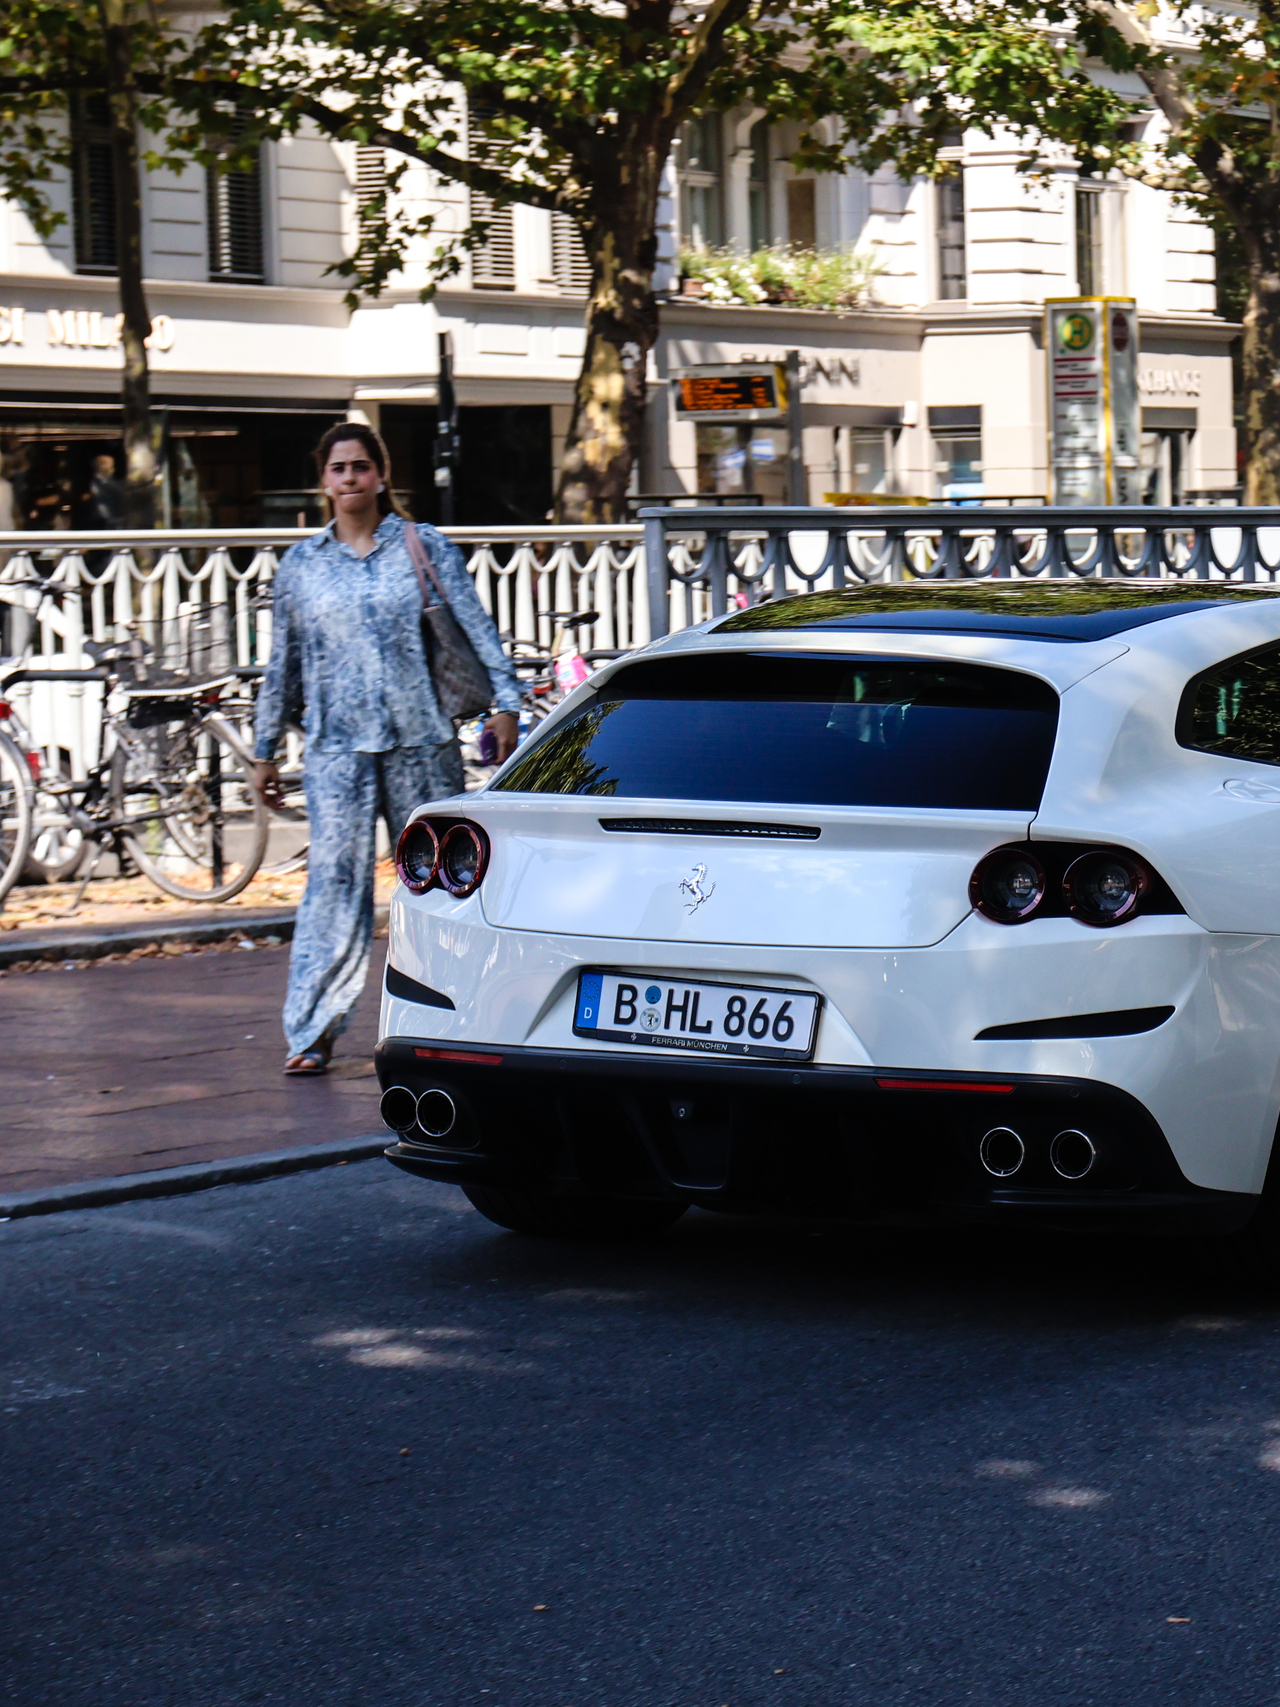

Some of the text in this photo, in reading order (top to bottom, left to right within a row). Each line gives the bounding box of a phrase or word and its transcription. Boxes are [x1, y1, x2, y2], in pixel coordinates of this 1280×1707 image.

[47, 309, 174, 350] MILAO
[583, 1007, 593, 1020] D
[613, 983, 795, 1042] B HL 866
[651, 1036, 728, 1051] FERRARI MÜNCHEN
